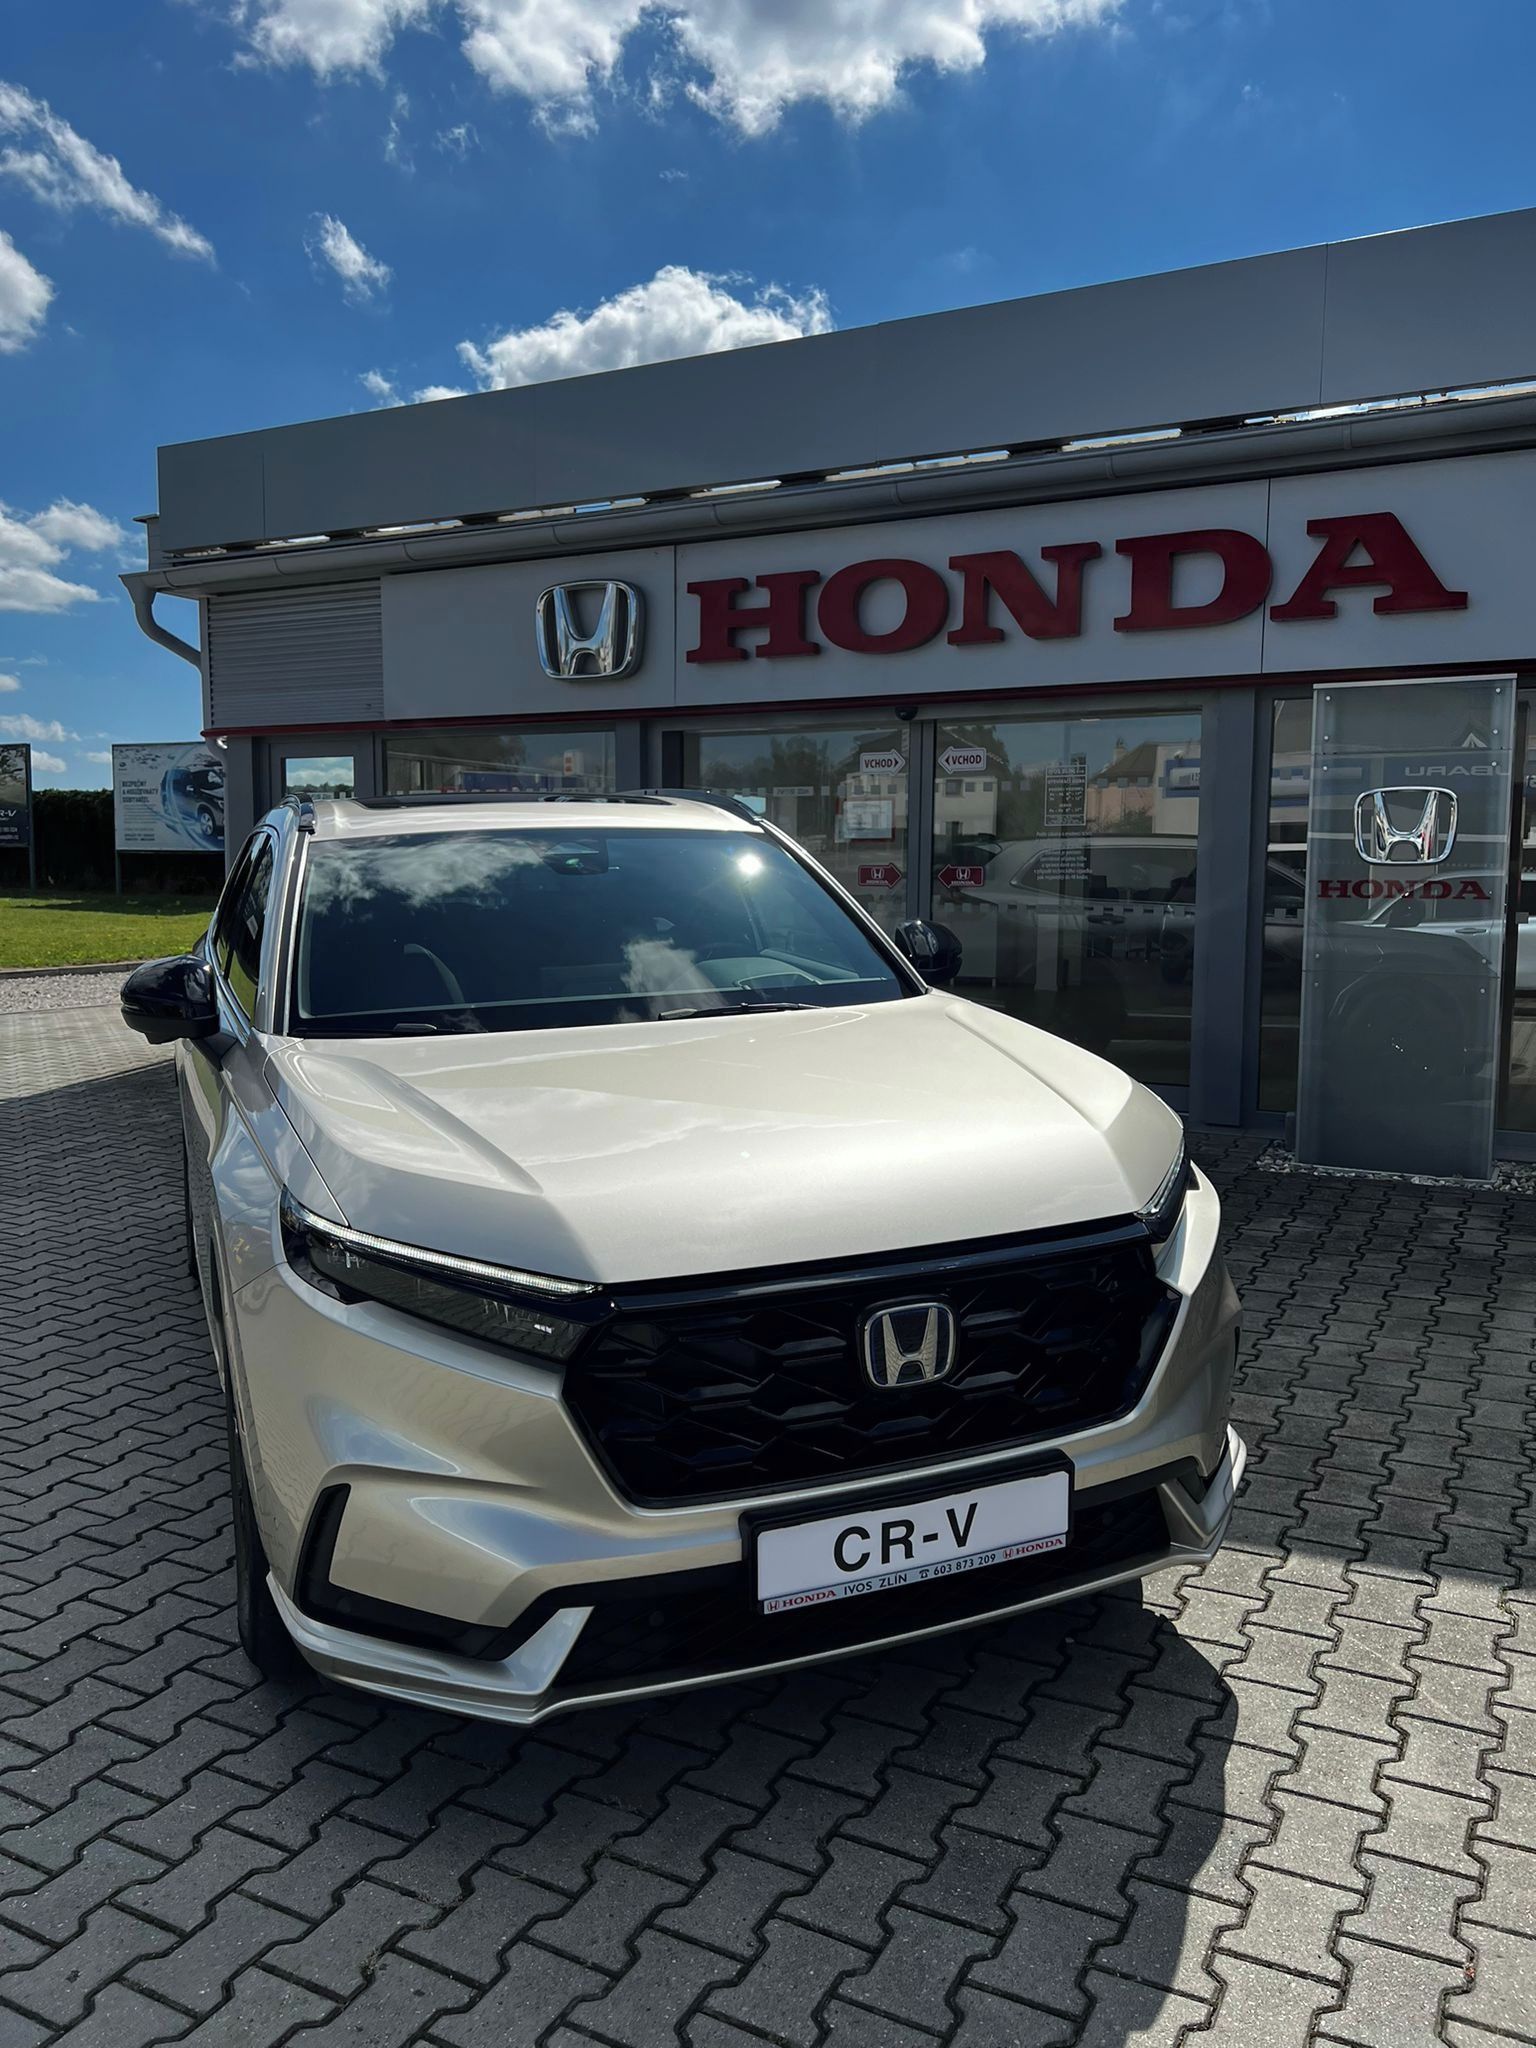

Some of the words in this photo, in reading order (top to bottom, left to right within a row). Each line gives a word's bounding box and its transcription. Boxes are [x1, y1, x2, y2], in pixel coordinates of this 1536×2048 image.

[687, 512, 1468, 663] HONDA
[864, 759, 893, 769] VCHOD
[952, 754, 982, 765] VCHOD
[1317, 879, 1490, 900] HONDA
[834, 1502, 979, 1573] CR-V
[783, 1589, 837, 1608] HONDA
[844, 1580, 873, 1596] IVOS
[879, 1573, 907, 1588] ZLÍN
[933, 1564, 952, 1576] 603
[956, 1558, 974, 1571] 873
[978, 1553, 996, 1566] 209
[1016, 1538, 1064, 1555] HONDA
